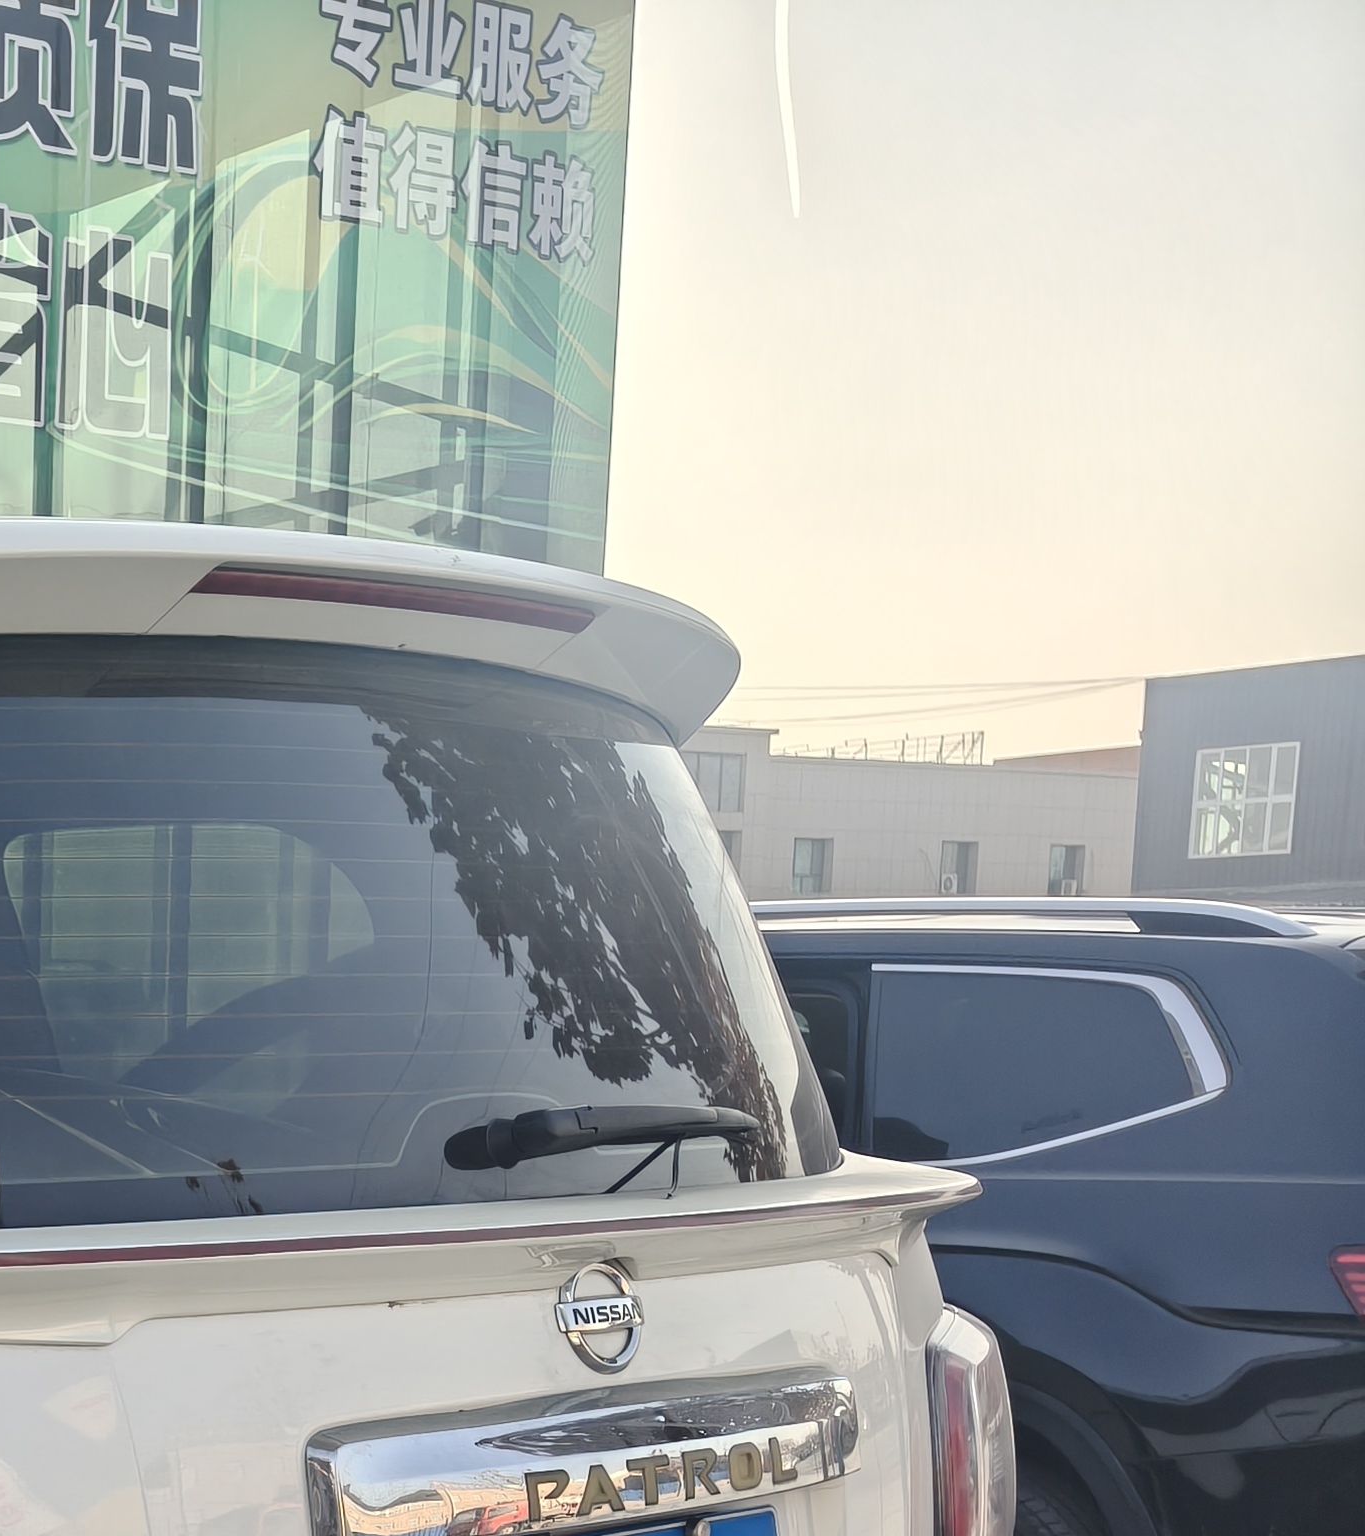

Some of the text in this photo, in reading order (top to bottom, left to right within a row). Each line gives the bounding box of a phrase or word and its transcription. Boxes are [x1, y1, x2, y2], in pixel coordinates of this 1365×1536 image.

[319, 0, 605, 129] 专业服务
[310, 104, 595, 267] 值得信赖
[571, 1302, 643, 1326] NISSAN
[525, 1436, 798, 1523] PATROL
